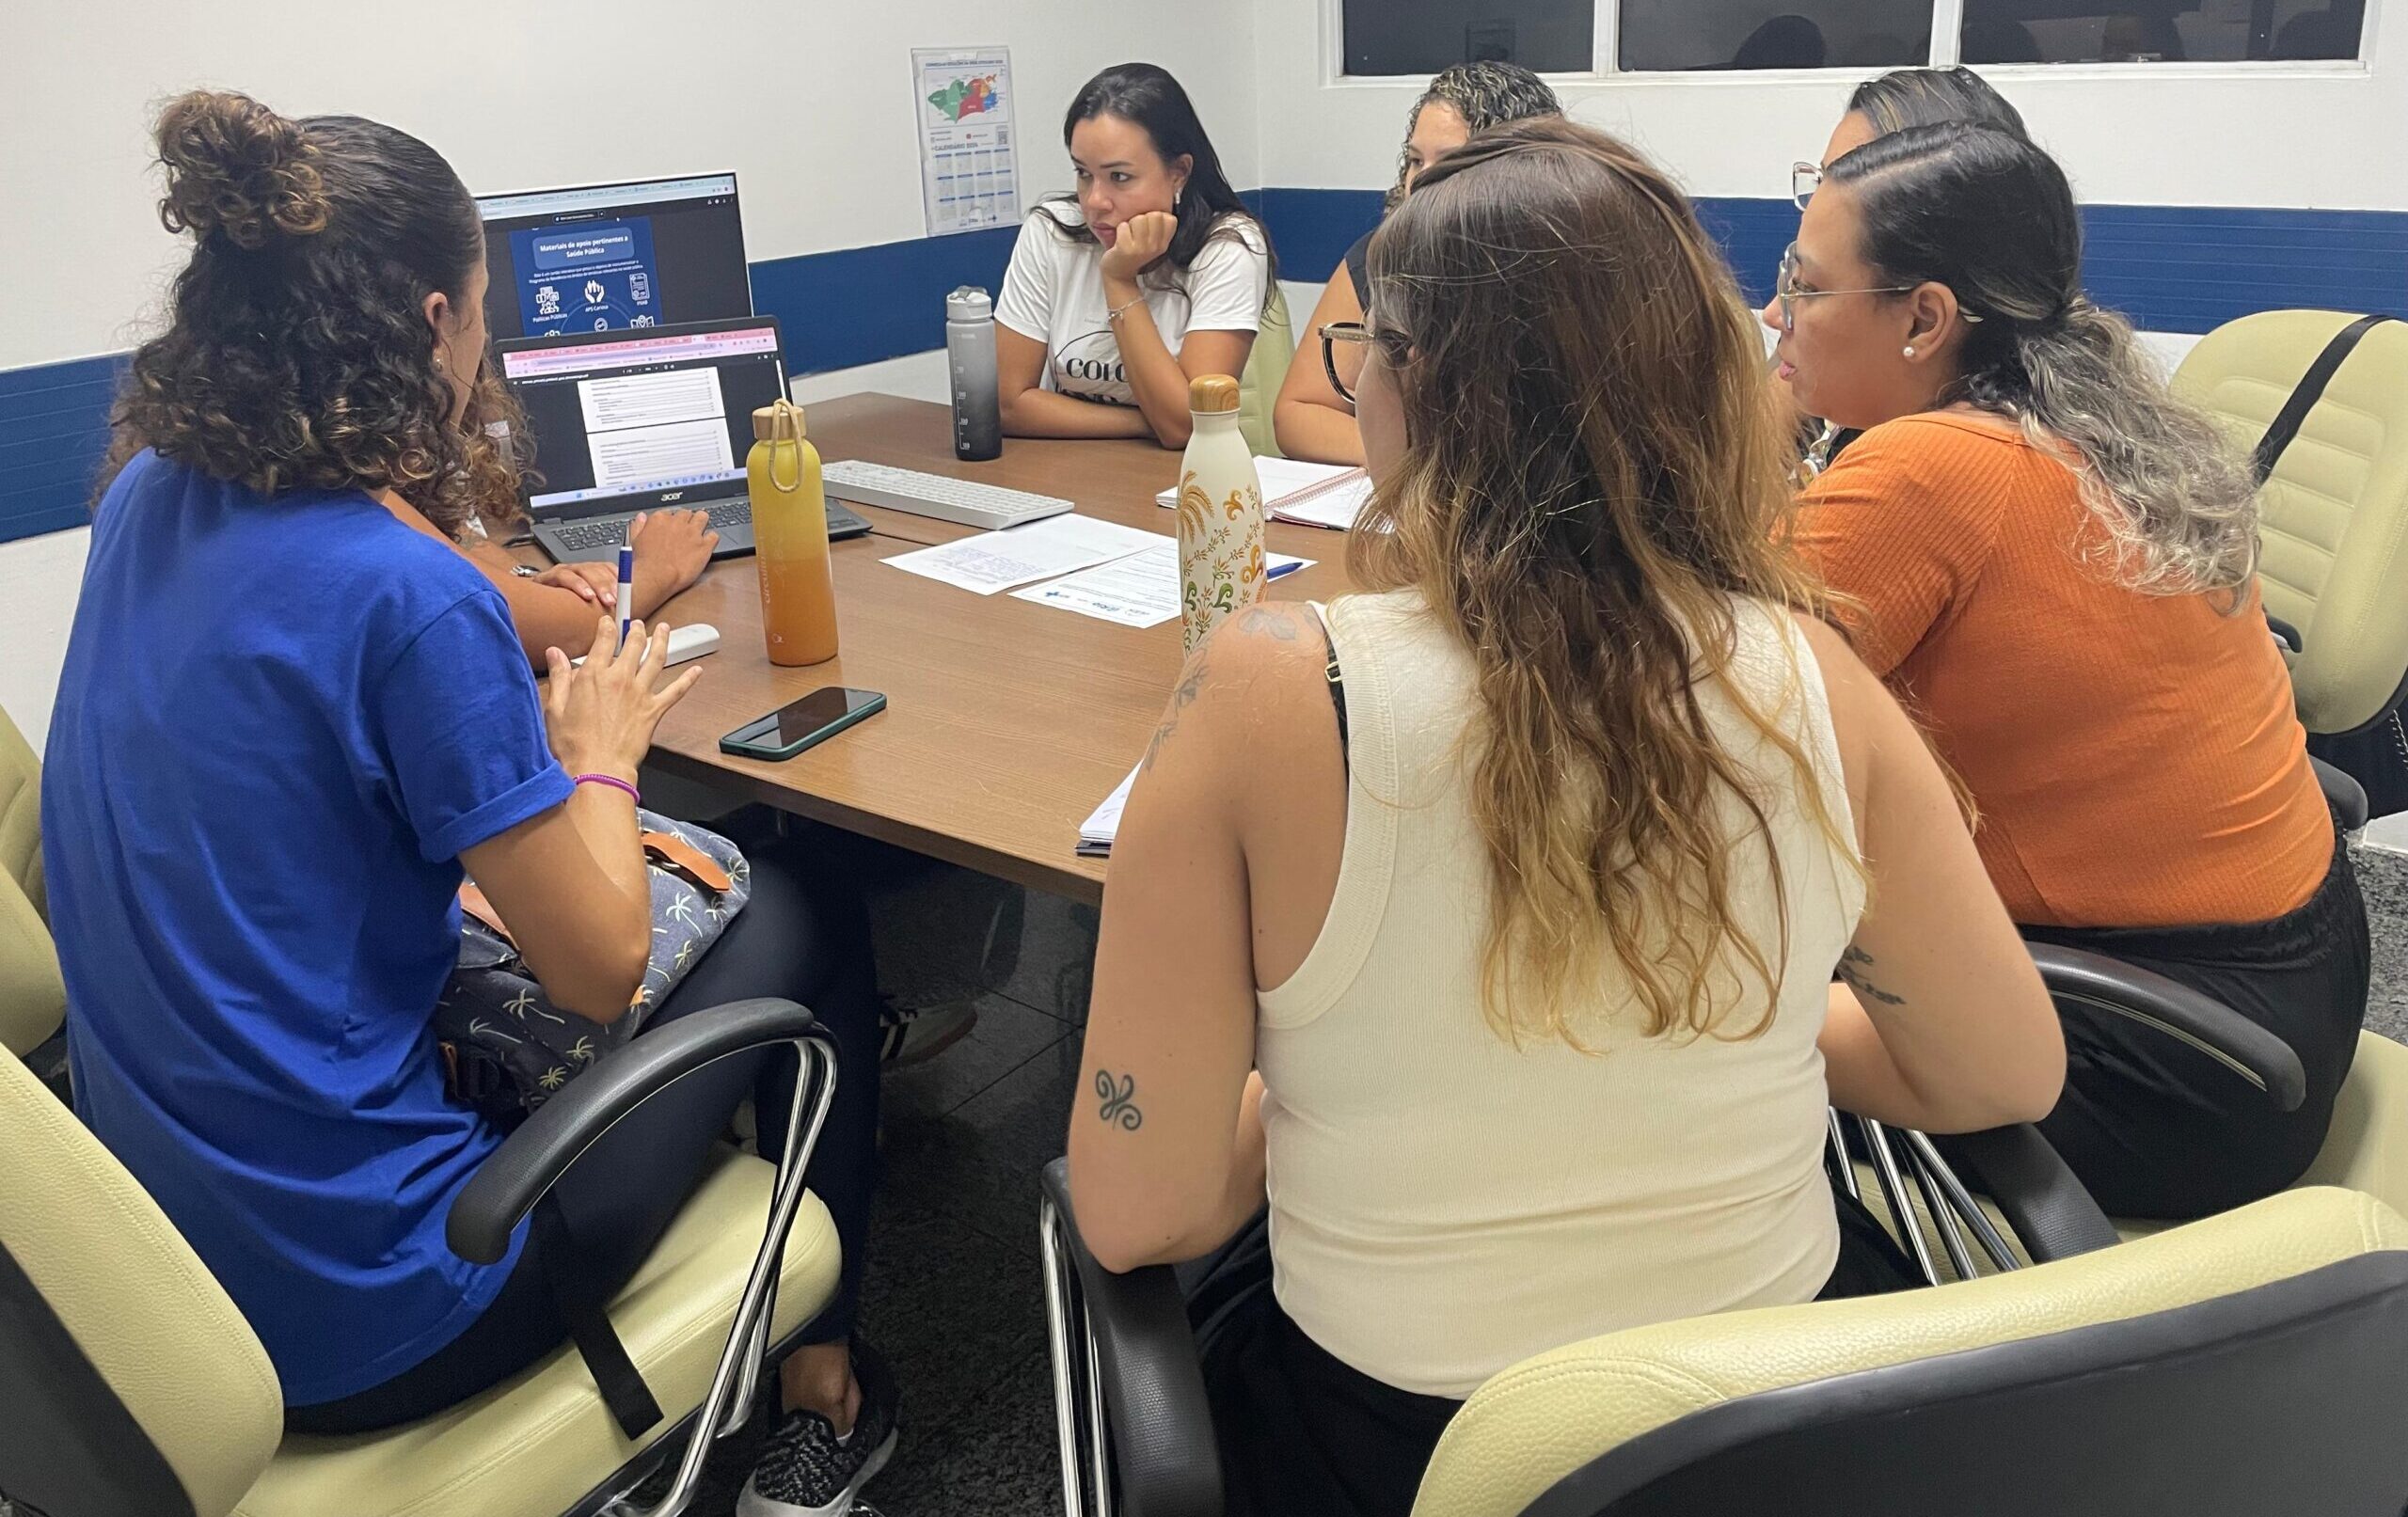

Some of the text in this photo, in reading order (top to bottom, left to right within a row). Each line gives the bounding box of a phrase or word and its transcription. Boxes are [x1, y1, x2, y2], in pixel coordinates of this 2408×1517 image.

[540, 243, 567, 252] Materiais
[576, 240, 592, 249] apoio
[593, 237, 623, 246] pertinentes
[585, 247, 604, 256] Pública
[660, 491, 683, 502] acer
